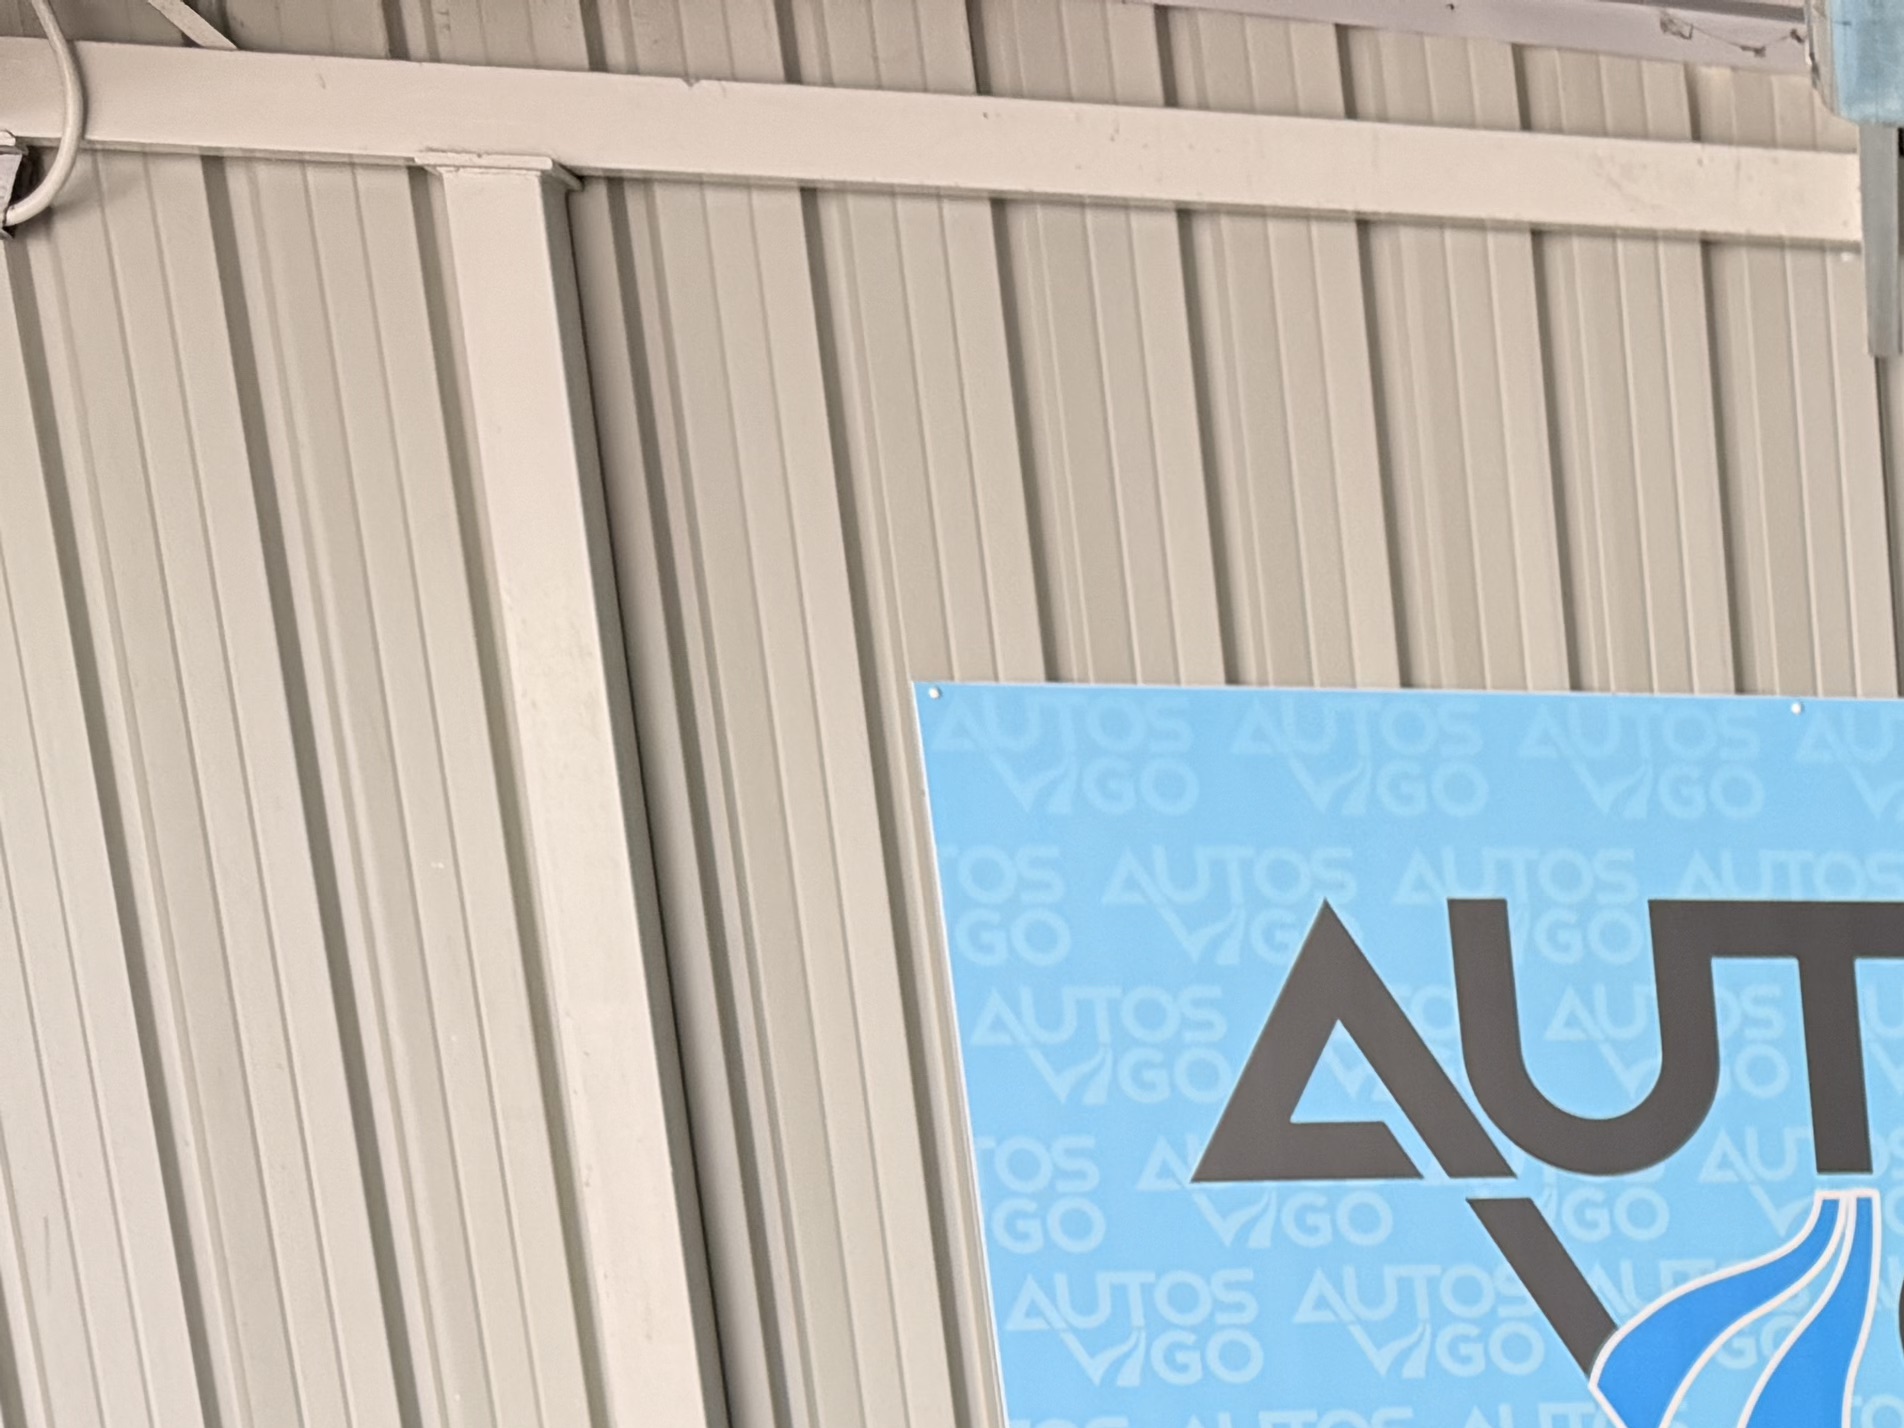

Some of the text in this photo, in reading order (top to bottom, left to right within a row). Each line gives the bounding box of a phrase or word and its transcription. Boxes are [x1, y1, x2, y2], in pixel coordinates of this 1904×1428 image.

[931, 693, 1194, 755] AUTOS
[1231, 696, 1484, 758] AUTOS
[1517, 702, 1761, 762] AUTOS
[988, 754, 1200, 815] VIGO
[1285, 756, 1489, 816] VIGO
[1570, 760, 1765, 819] VIGO
[1102, 845, 1358, 905] AUTOS
[1393, 847, 1639, 906] AUTOS
[968, 986, 1227, 1047] AUTOS
[1024, 1046, 1232, 1104] VIGO
[1190, 1191, 1393, 1248] VIGO
[1004, 1268, 1259, 1332] AUTOS
[1059, 1328, 1264, 1386] VIGO
[1347, 1320, 1544, 1377] VIGO
